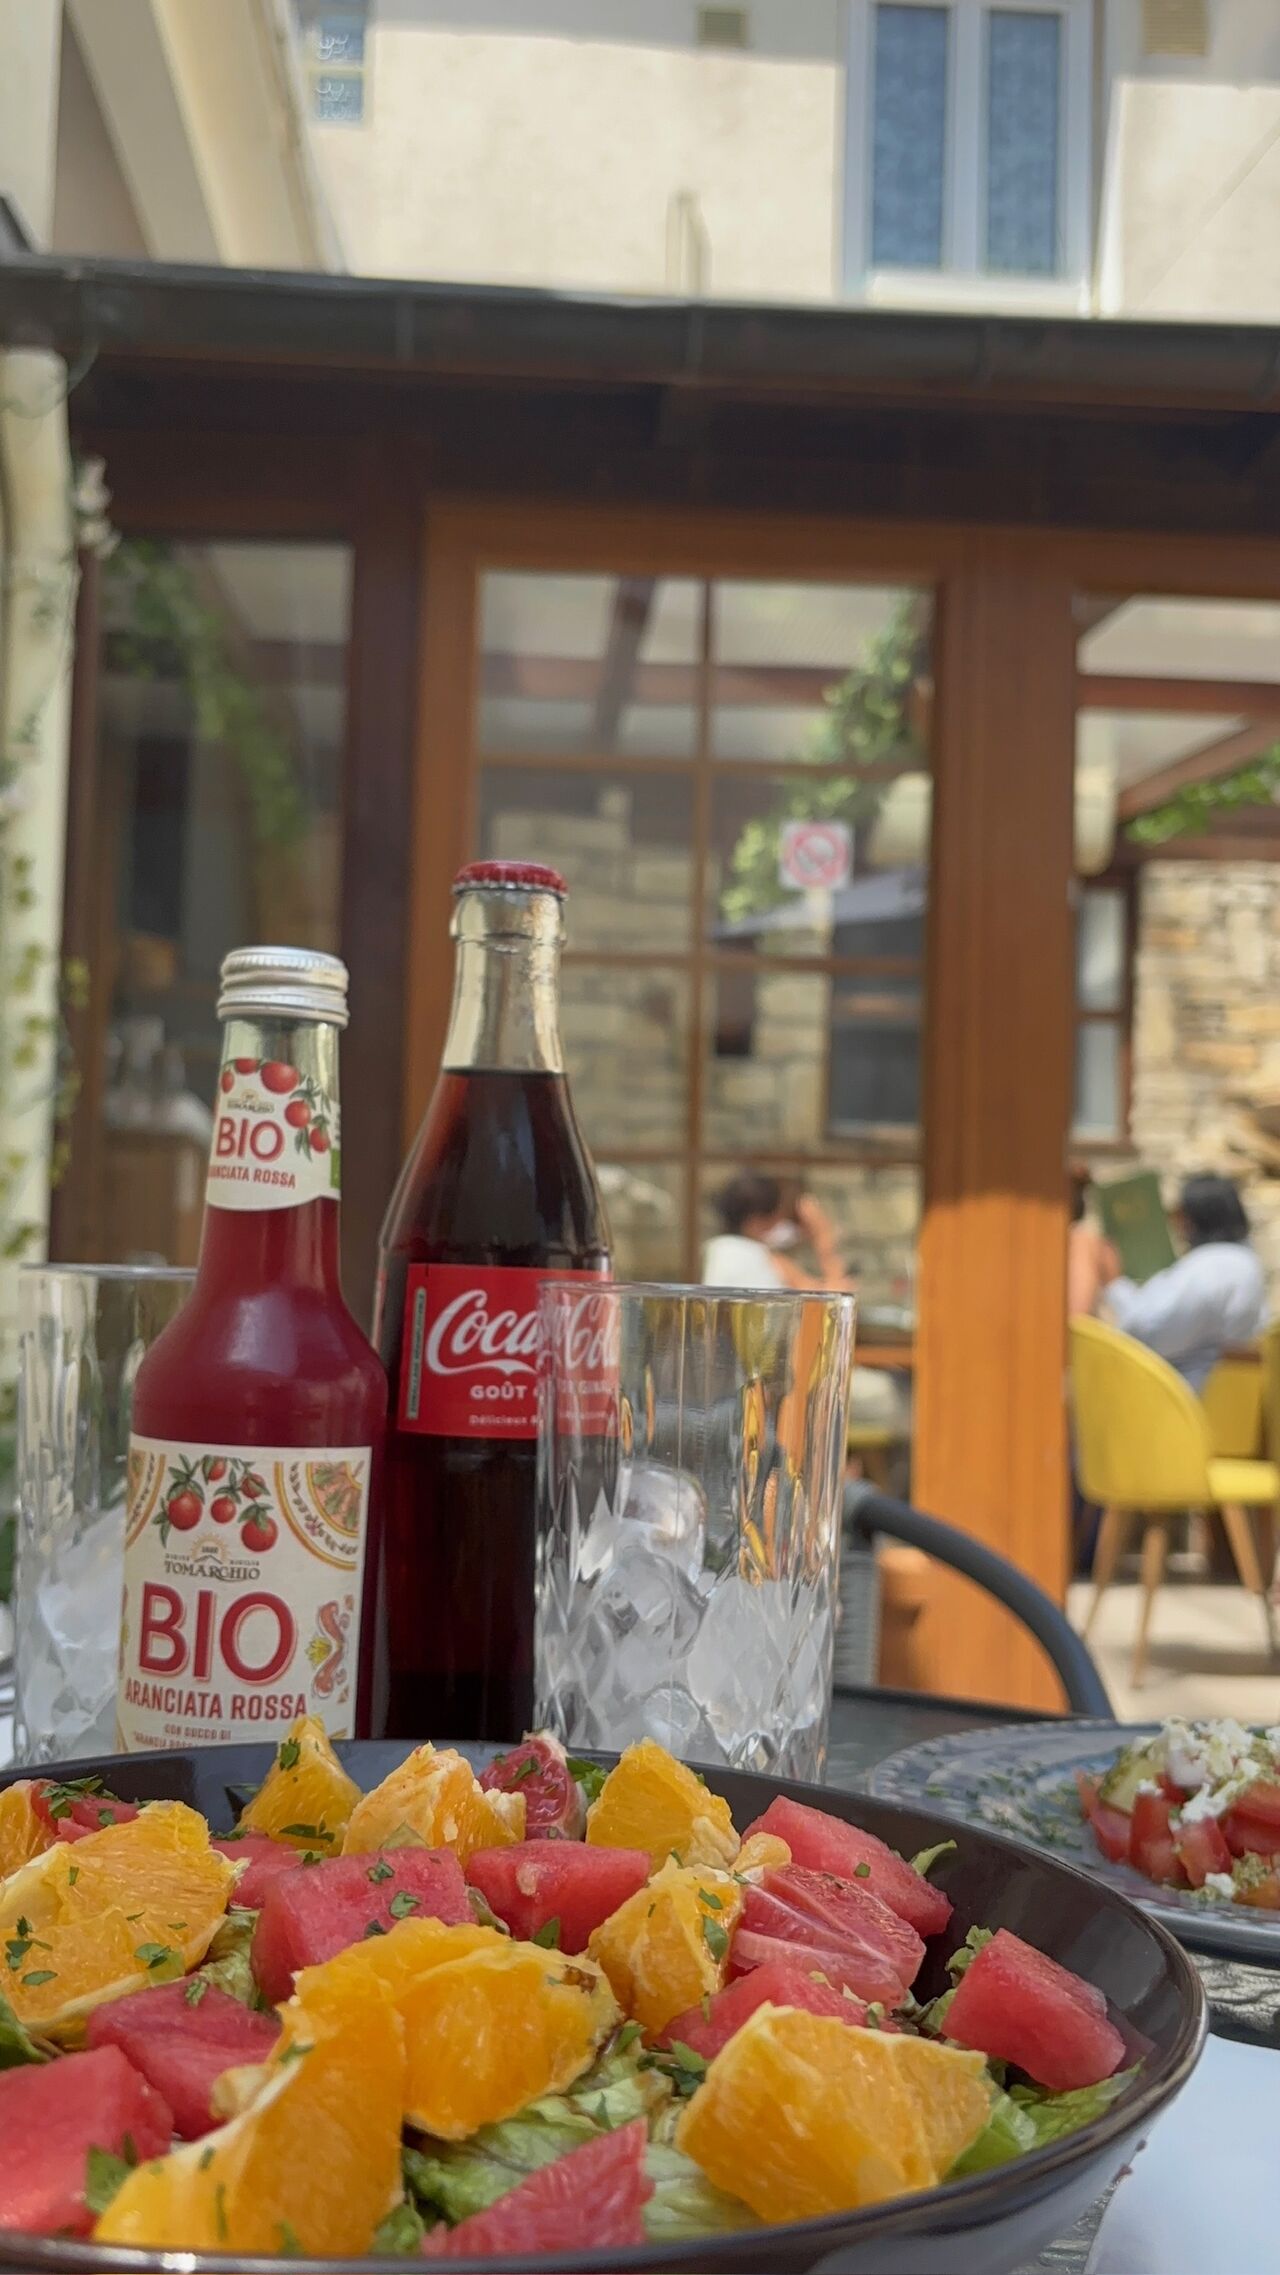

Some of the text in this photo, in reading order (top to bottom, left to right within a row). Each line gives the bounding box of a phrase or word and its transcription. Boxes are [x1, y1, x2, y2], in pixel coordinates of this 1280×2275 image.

[216, 1117, 285, 1163] BIO
[254, 1167, 296, 1189] ROSSA
[469, 1381, 528, 1400] GOÛT
[164, 1560, 260, 1583] TOMARCHIO
[139, 1581, 297, 1687] BIO
[125, 1678, 307, 1720] ARANCIATA ROSSA
